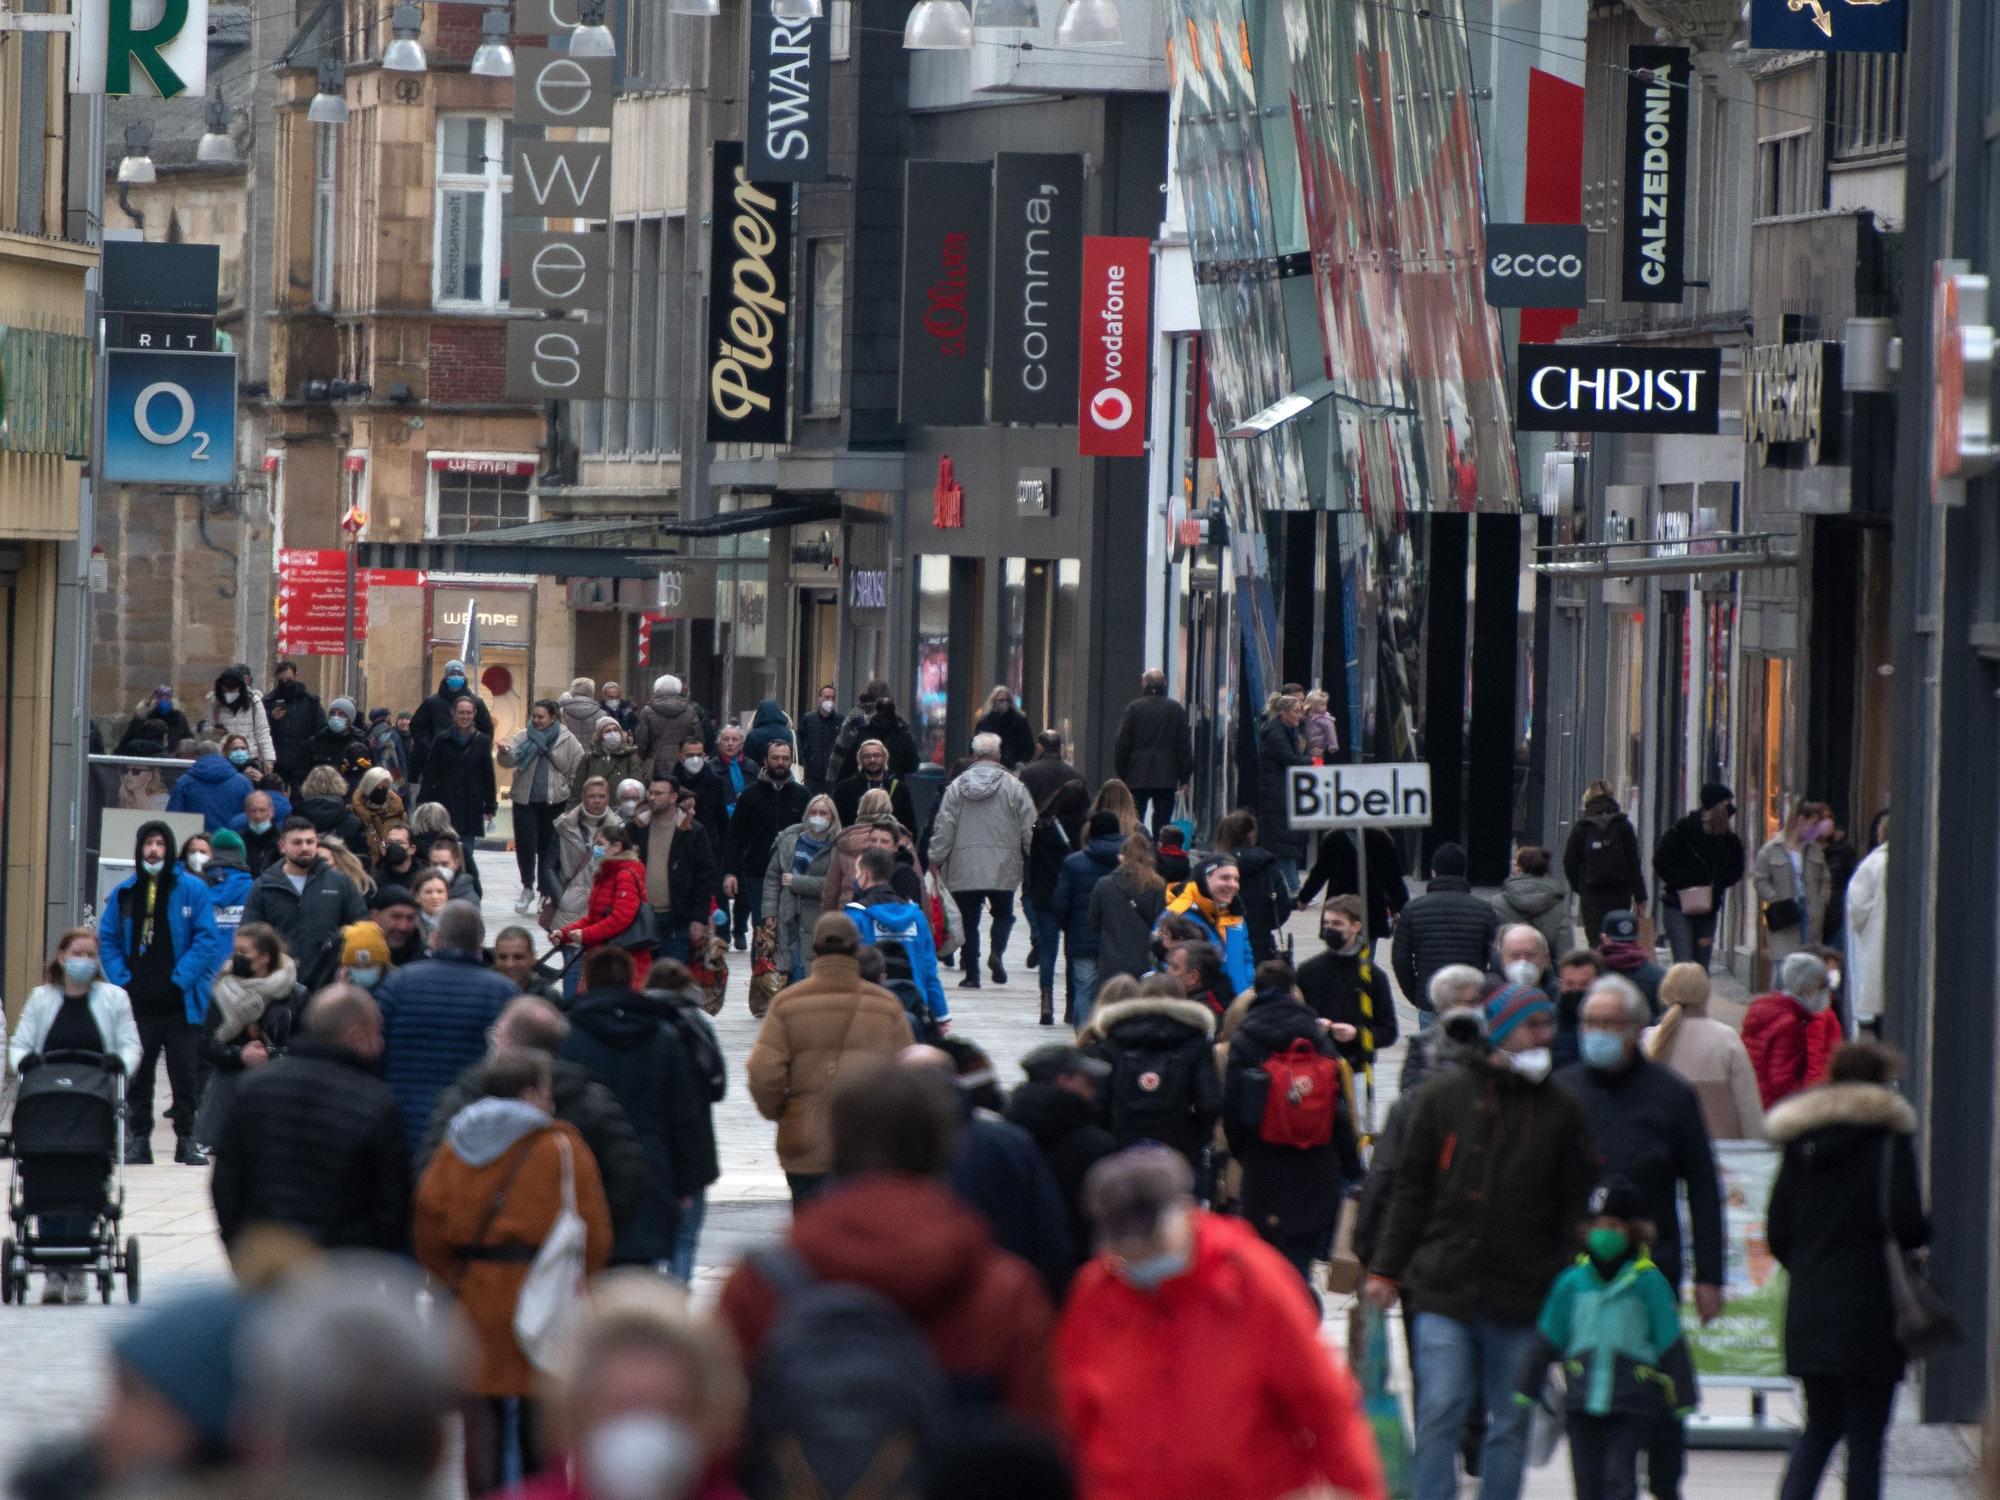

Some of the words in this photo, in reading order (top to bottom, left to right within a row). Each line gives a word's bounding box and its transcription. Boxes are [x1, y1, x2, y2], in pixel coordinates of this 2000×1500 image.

[1641, 64, 1673, 286] CALZEDONIA
[711, 165, 787, 421] Pieper
[1022, 184, 1059, 391] comma,
[1101, 264, 1126, 382] vodafone
[1491, 253, 1582, 278] ecco
[1530, 365, 1707, 413] CHRIST
[1292, 768, 1427, 817] Bibeln
